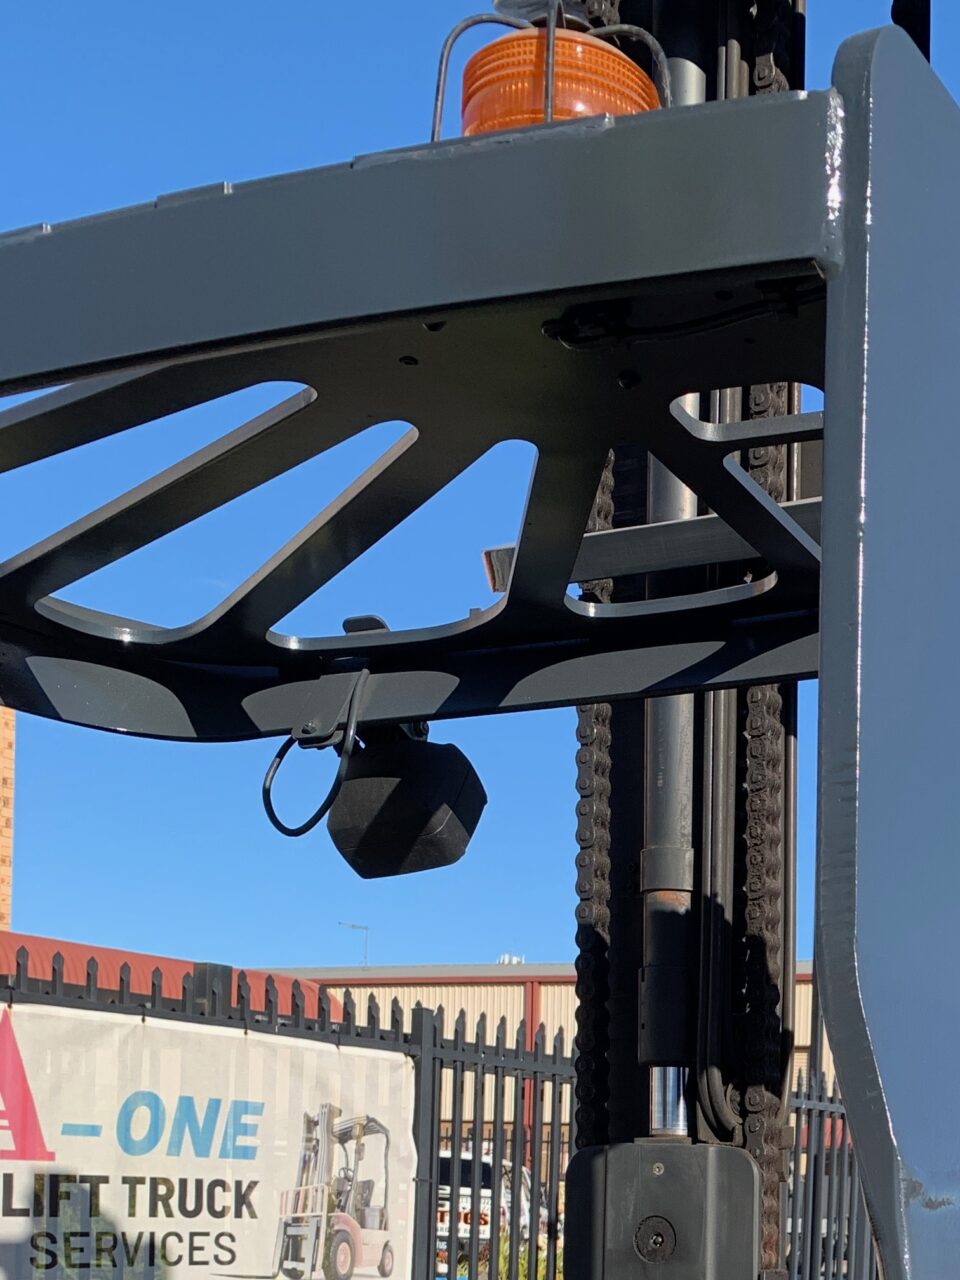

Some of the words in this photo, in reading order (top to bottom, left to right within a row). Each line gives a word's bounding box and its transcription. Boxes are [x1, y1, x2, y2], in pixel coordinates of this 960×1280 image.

[2, 1172, 110, 1218] LIFT
[121, 1175, 260, 1220] TRUCK
[29, 1231, 237, 1270] SERVICES
